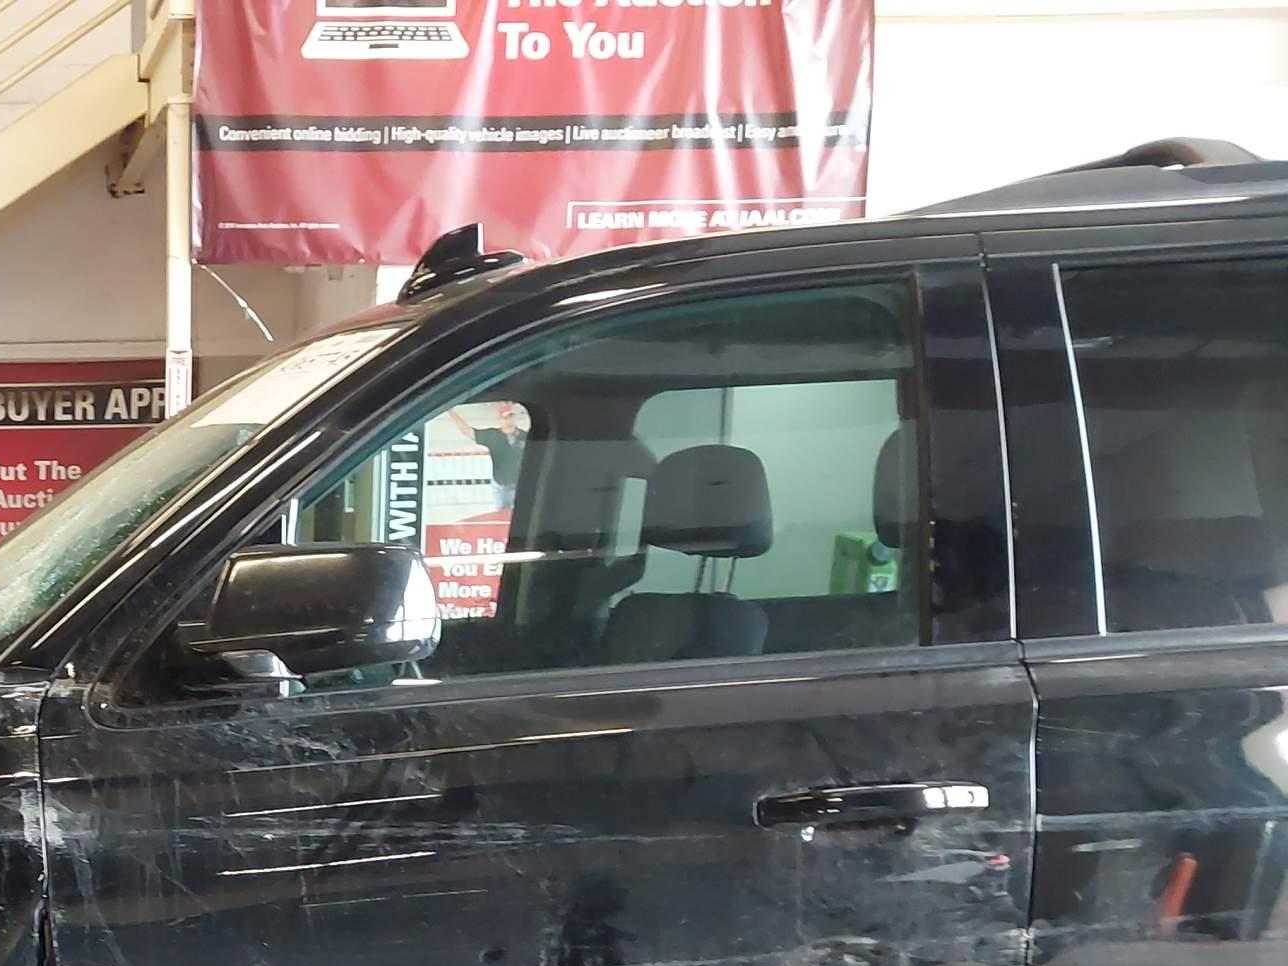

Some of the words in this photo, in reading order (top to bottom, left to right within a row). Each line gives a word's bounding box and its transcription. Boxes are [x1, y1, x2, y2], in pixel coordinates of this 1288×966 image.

[497, 22, 550, 60] To
[563, 22, 645, 60] You
[219, 126, 292, 141] Convenient
[294, 127, 331, 141] online
[334, 127, 381, 144] bidding
[391, 126, 466, 144] High-quality
[468, 127, 513, 142] vehicle
[515, 127, 564, 143] images
[572, 126, 599, 141] Live
[600, 126, 669, 141] auctioneer
[672, 124, 736, 140] broadst
[577, 212, 644, 229] LEARN
[648, 211, 708, 228] MORE
[34, 461, 82, 481] The
[389, 462, 418, 541] WITH
[440, 537, 473, 555] We
[476, 537, 508, 554] He
[441, 560, 479, 577] You
[438, 581, 493, 599] More
